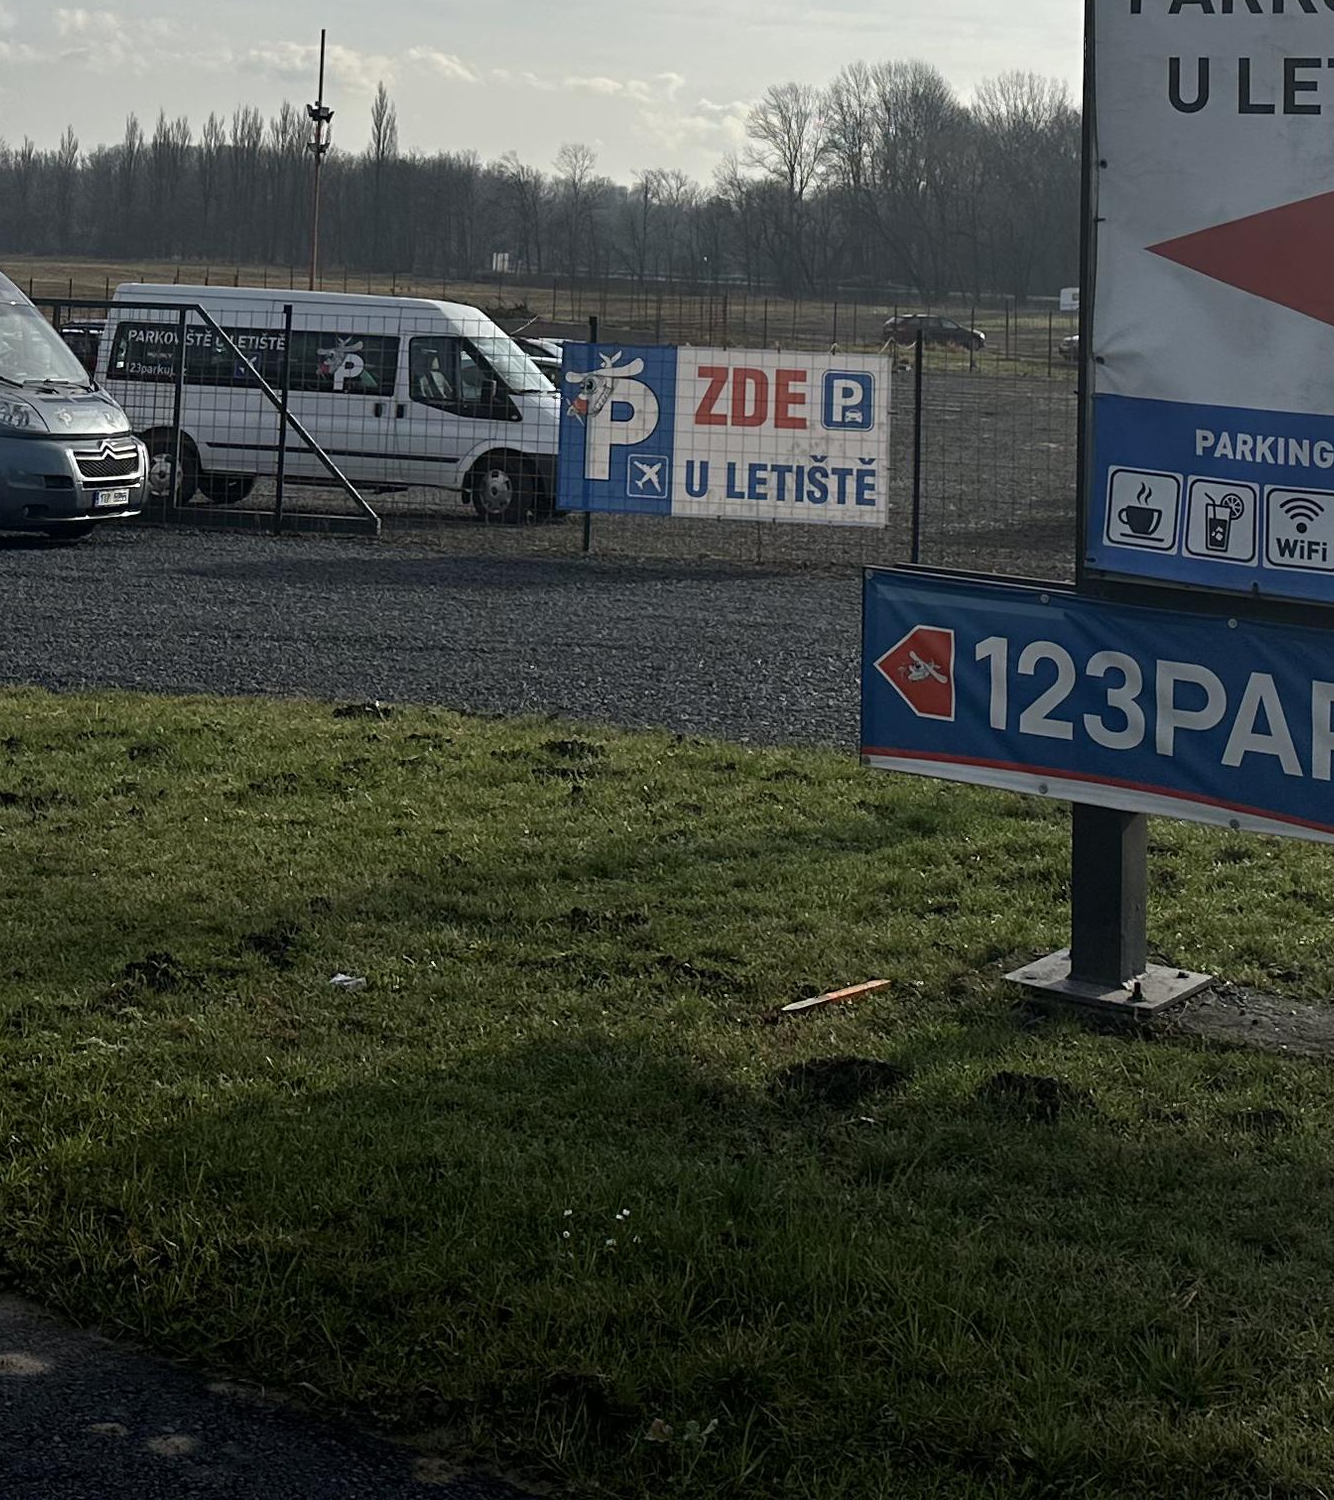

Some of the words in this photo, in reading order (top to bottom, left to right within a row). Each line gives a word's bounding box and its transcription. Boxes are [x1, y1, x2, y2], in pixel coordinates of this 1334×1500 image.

[1168, 56, 1210, 114] U
[694, 366, 808, 430] ZDE
[584, 378, 660, 481] P
[1195, 429, 1334, 469] PARKING
[685, 460, 709, 498] U
[726, 455, 877, 506] LETIŠTĚ
[1276, 538, 1329, 563] WiFi
